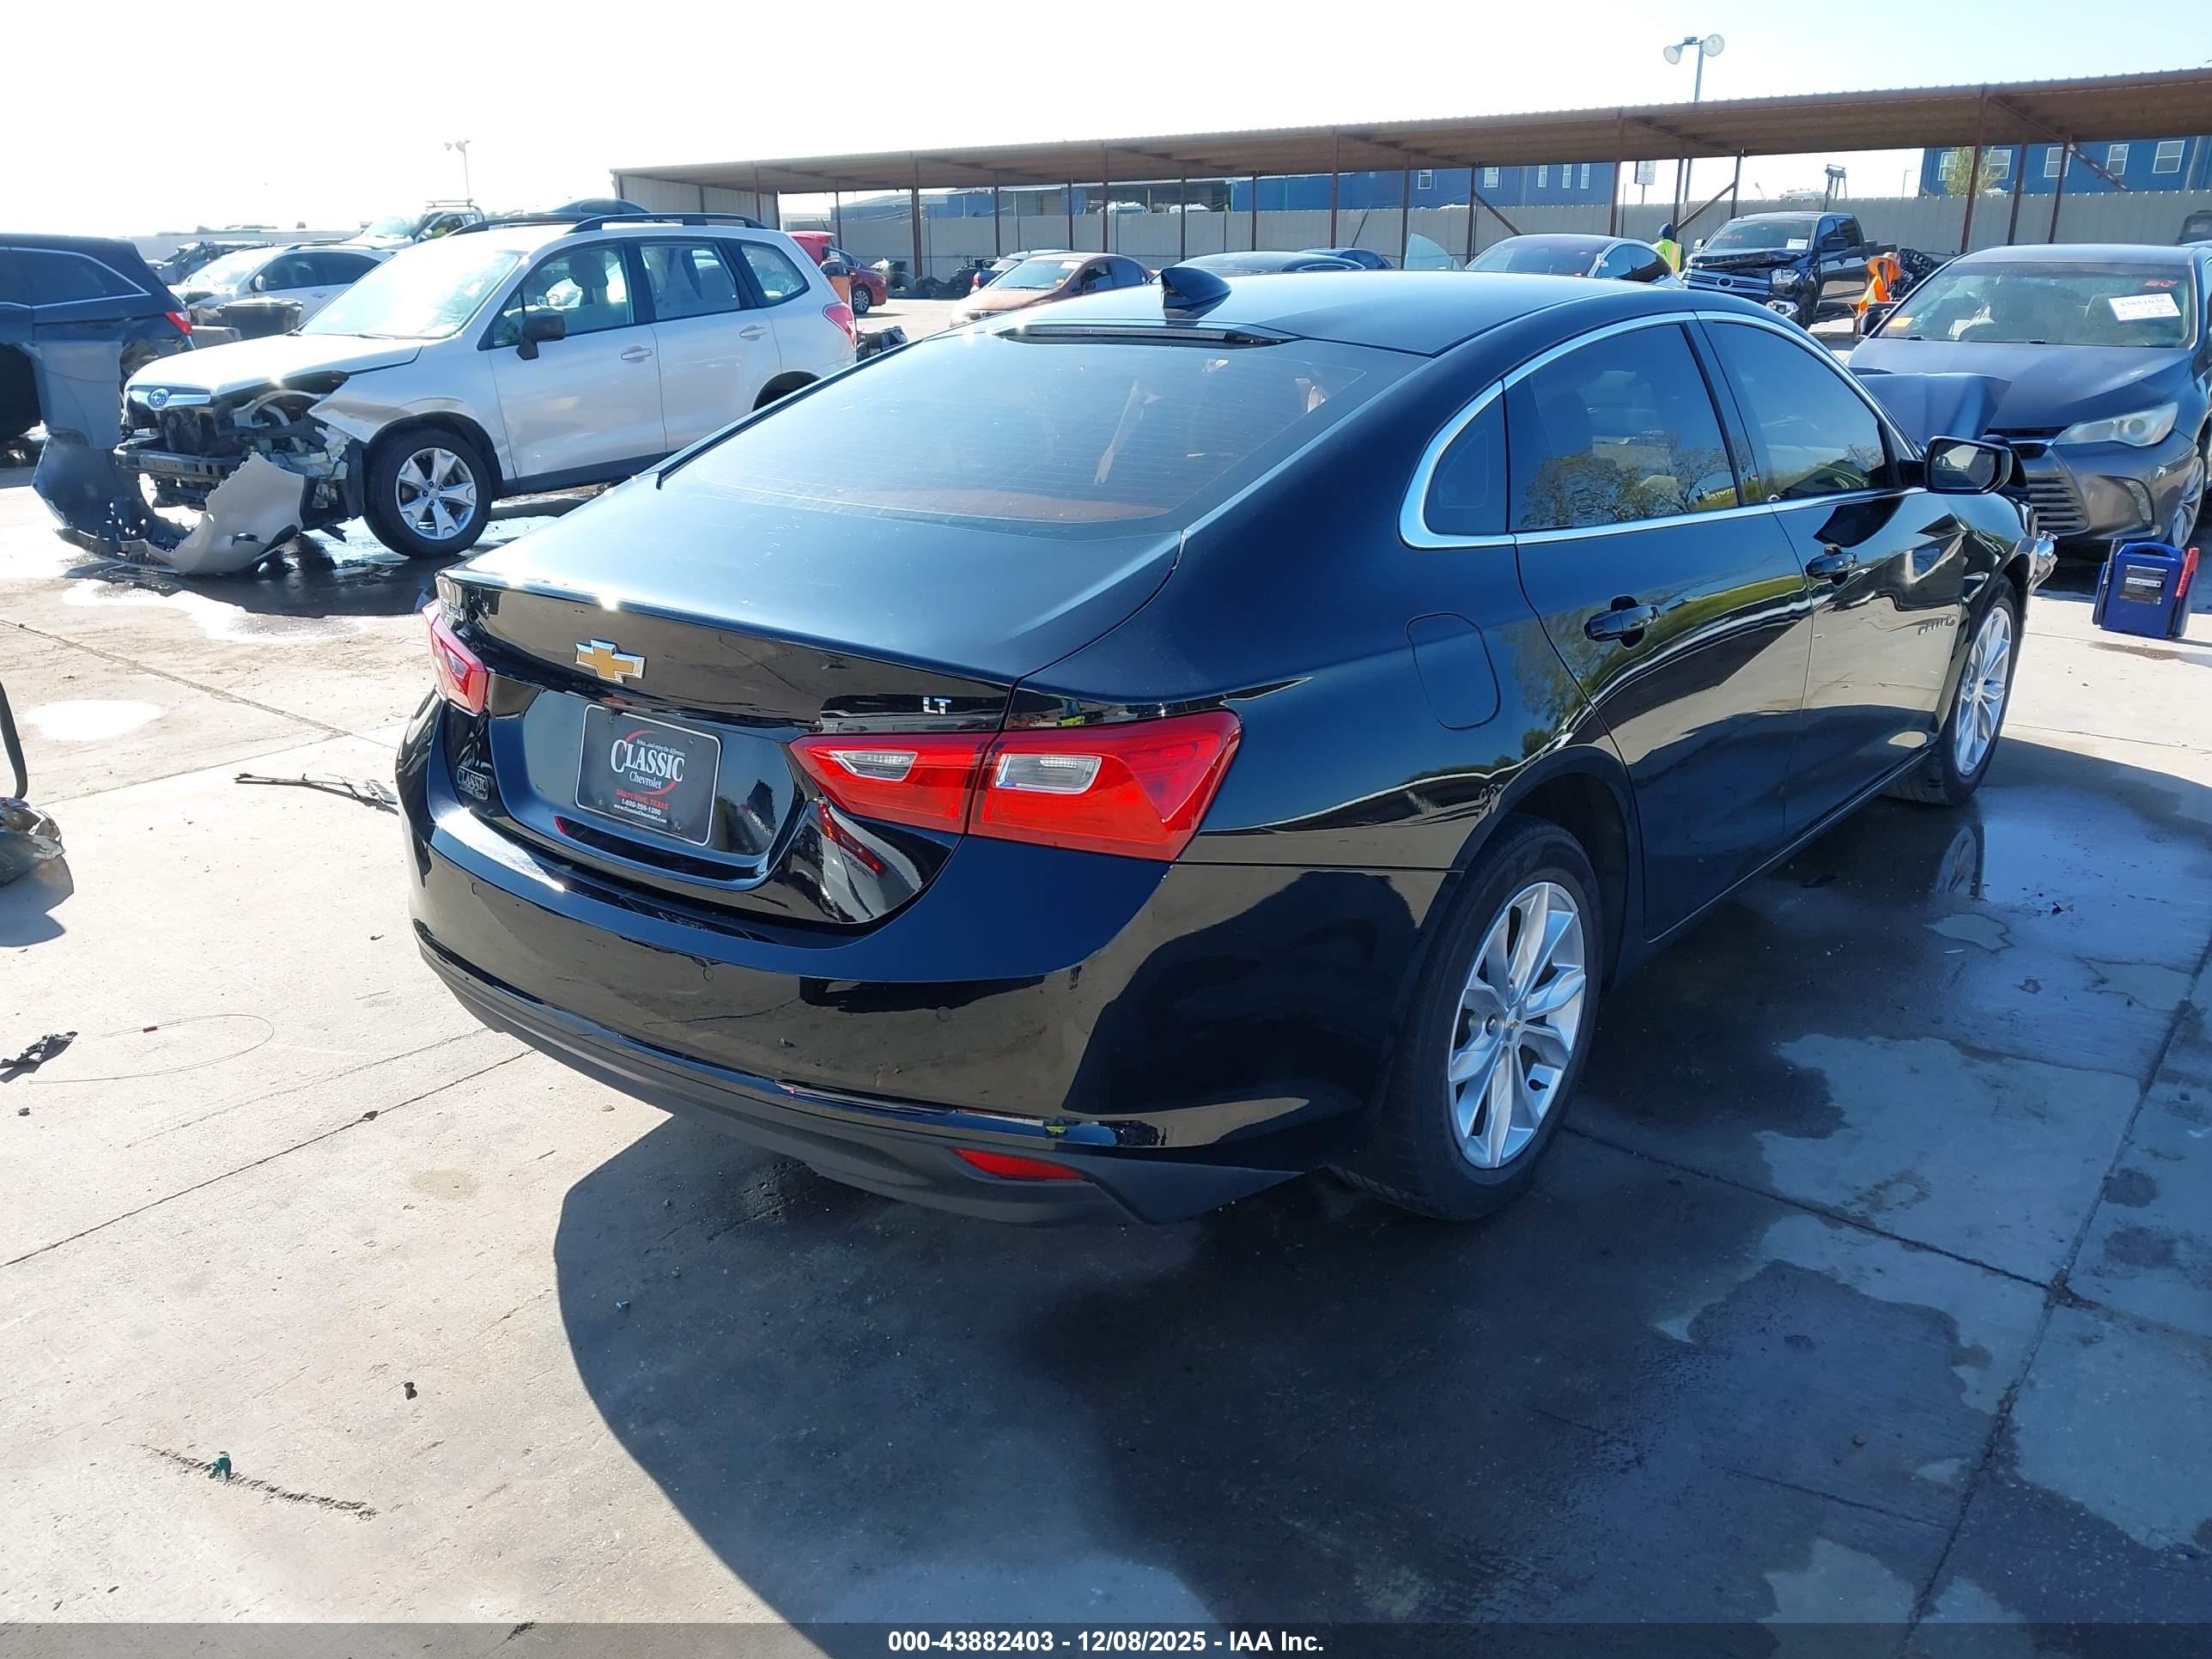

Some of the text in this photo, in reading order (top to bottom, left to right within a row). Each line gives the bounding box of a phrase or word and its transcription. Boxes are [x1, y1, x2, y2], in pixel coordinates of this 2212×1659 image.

[923, 696, 952, 714] LT
[611, 738, 685, 782] CLASSIC
[629, 770, 662, 790] Chevrolet
